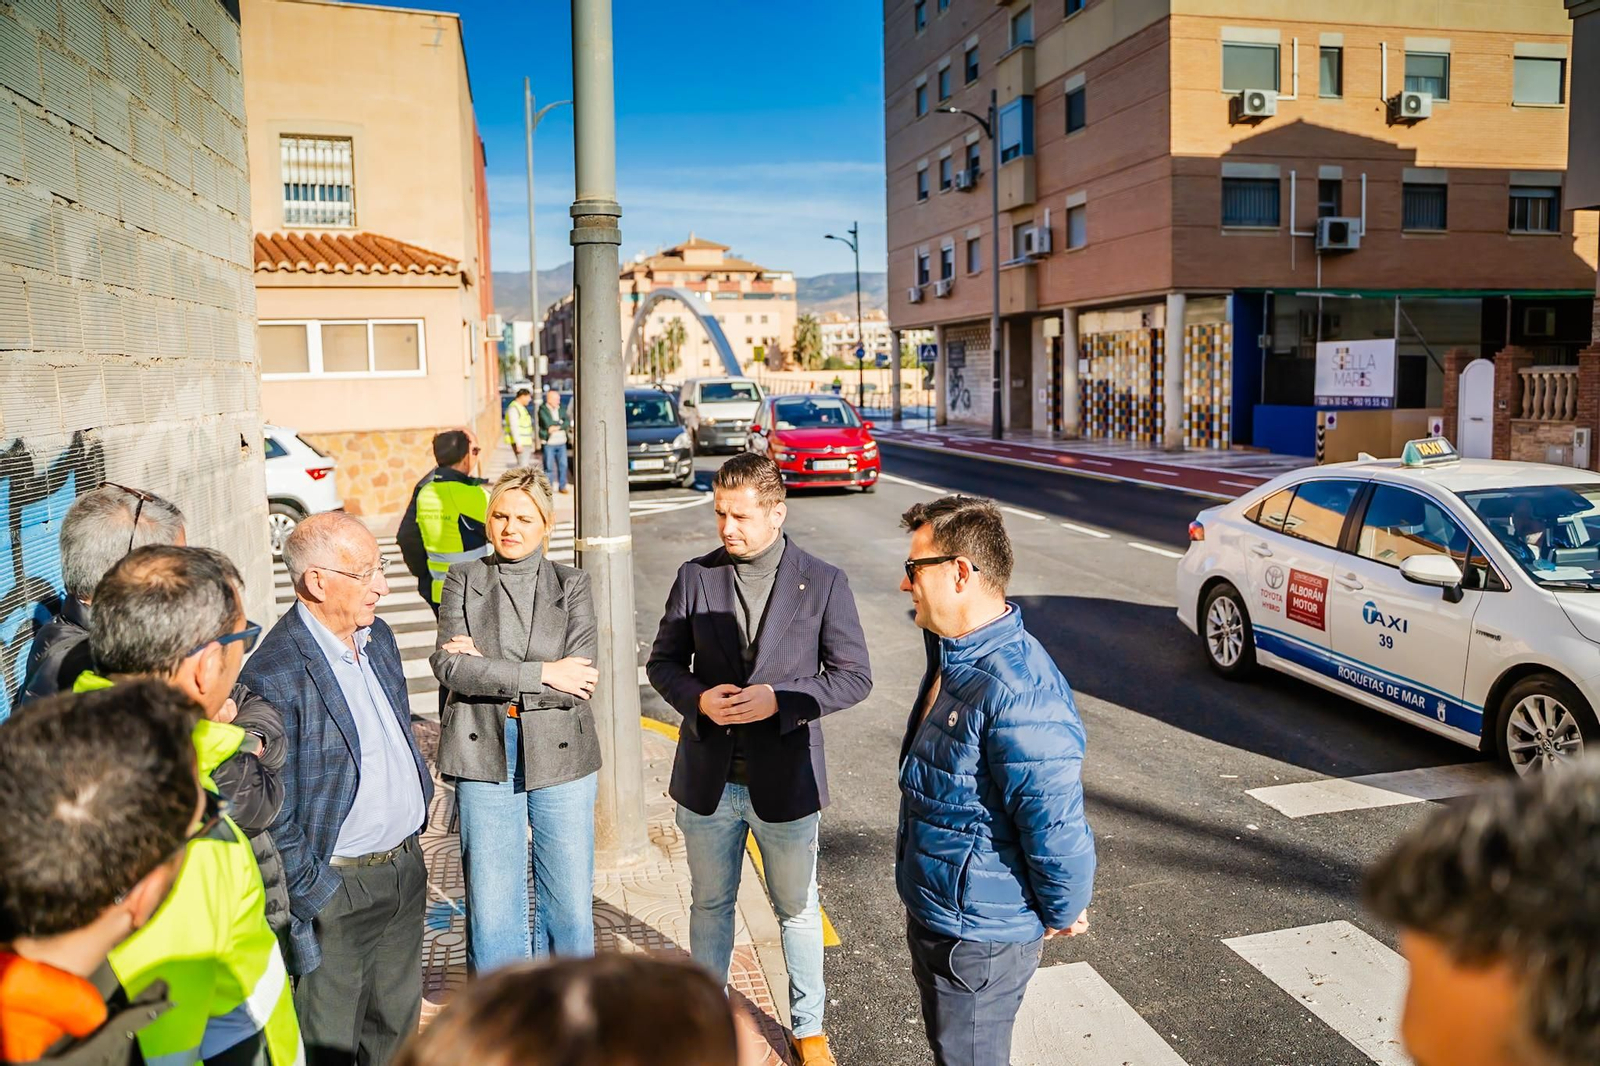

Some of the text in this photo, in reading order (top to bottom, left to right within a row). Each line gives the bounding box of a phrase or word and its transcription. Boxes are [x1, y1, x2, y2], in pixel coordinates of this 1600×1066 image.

[1415, 441, 1443, 456] TAXI
[1260, 588, 1283, 604] TOYOTA
[1289, 583, 1324, 603] ALBORÁN
[1262, 601, 1281, 613] HYBRID
[1292, 597, 1318, 614] MOTOR
[1363, 602, 1408, 634] TAXI
[1379, 633, 1394, 650] 39
[1338, 665, 1426, 709] ROQUETAS DE MAR
